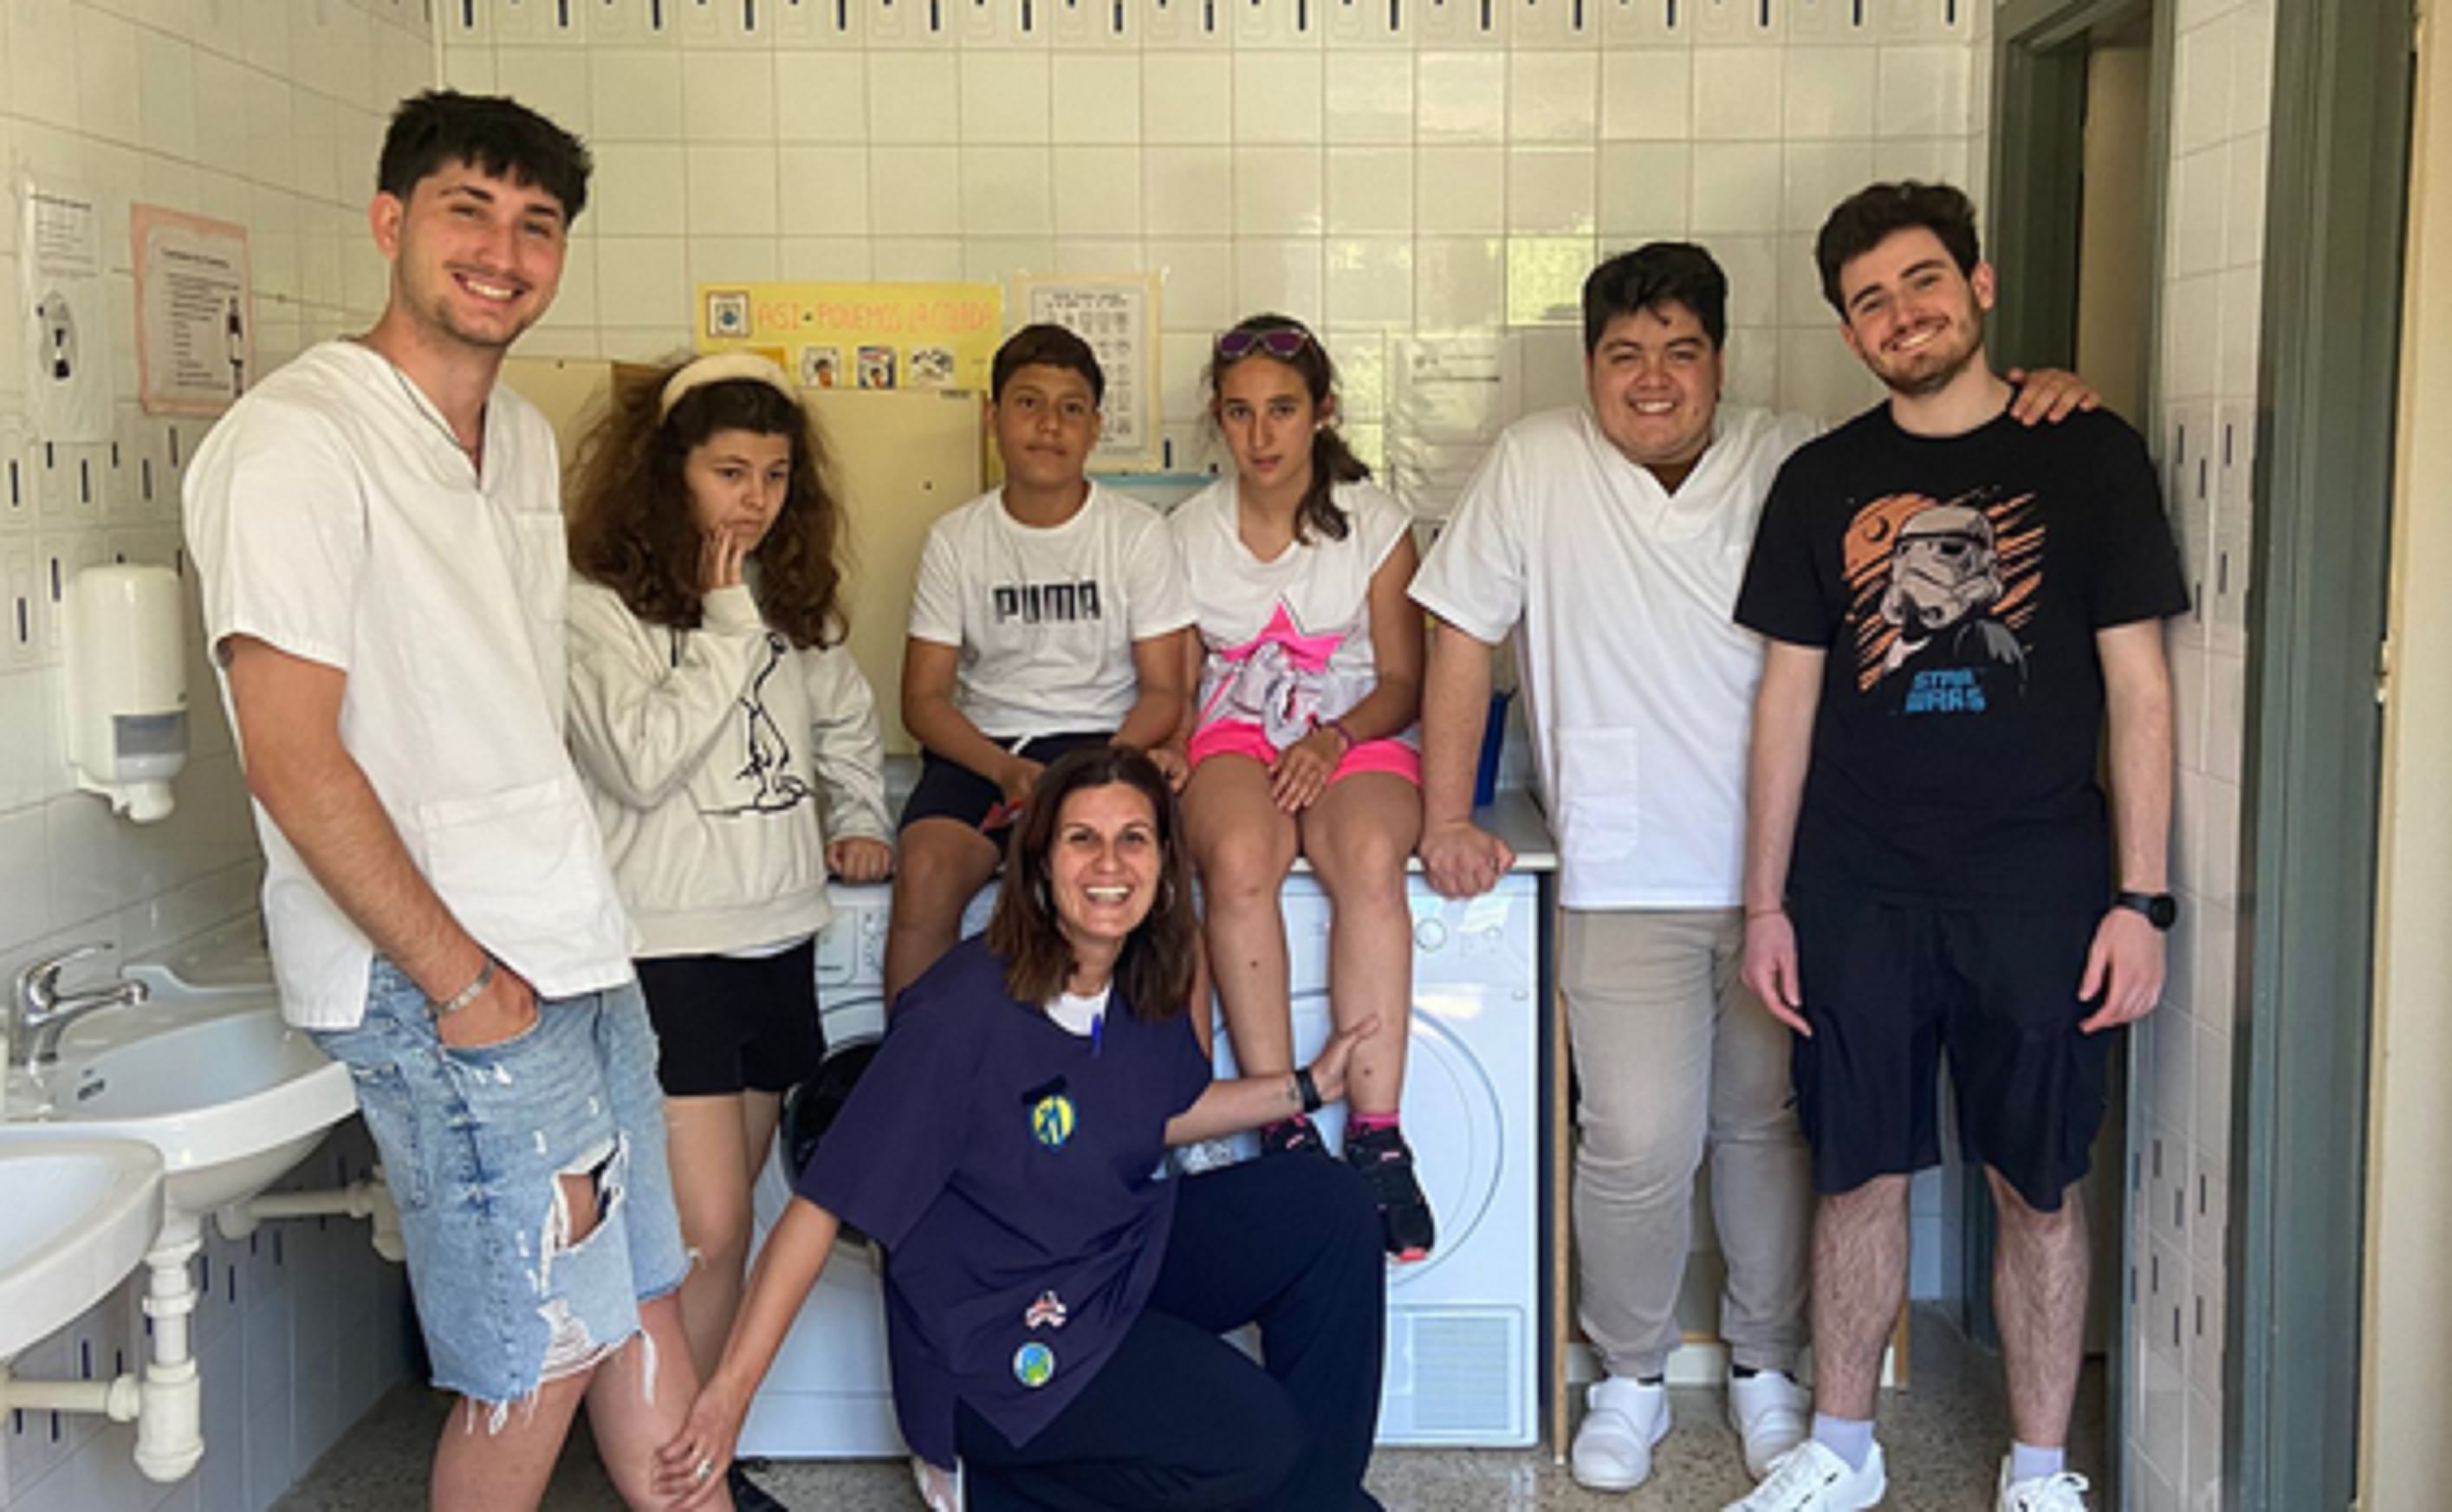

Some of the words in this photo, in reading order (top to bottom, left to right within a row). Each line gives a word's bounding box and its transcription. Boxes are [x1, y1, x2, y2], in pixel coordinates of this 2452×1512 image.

[993, 580, 1102, 625] PUMA
[1914, 668, 1975, 689] STAR
[1905, 687, 1985, 711] WARS
